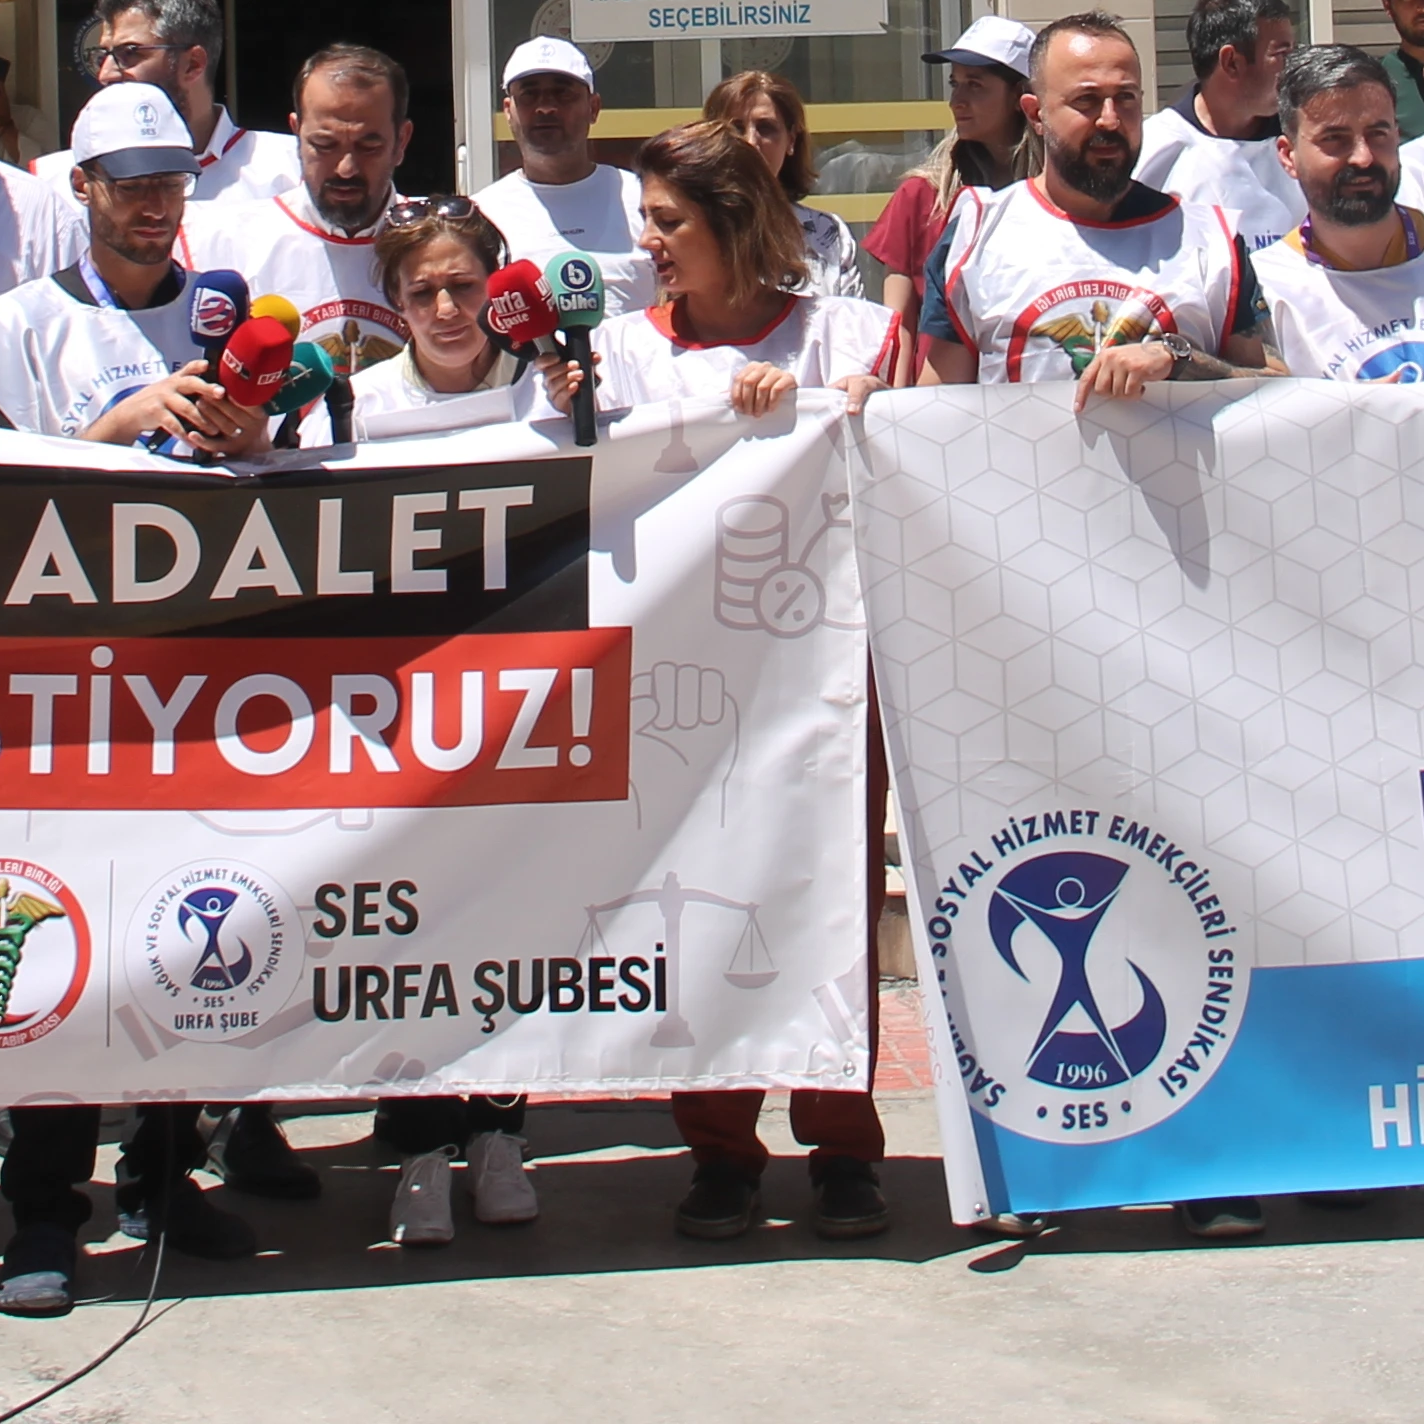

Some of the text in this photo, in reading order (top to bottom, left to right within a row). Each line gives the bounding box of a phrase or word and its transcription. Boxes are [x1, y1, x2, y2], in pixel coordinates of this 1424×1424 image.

[648, 0, 813, 32] SEÇEBİLİRSİNİZ
[1344, 318, 1411, 353] HİZMET
[91, 360, 164, 390] HİZMET
[4, 485, 533, 607] ADALET
[991, 809, 1101, 858] HİZMET
[25, 865, 65, 895] BİRLİĞİ
[1107, 814, 1238, 939] EMEKÇİLERİ
[312, 879, 420, 940] SES
[928, 850, 994, 958] SOSYAL
[145, 867, 285, 998] SAĞLIK VE SOSYAL HİZMET EMEKÇİLERİ SENDİKASI
[203, 995, 225, 1008] SES
[312, 942, 669, 1034] URFA ŞUBESİ
[29, 1012, 62, 1040] ODASI
[174, 1010, 260, 1033] URFA ŞUBE
[1157, 948, 1235, 1098] SENDİKASI
[1053, 1062, 1109, 1085] 1996
[1061, 1101, 1109, 1130] SES
